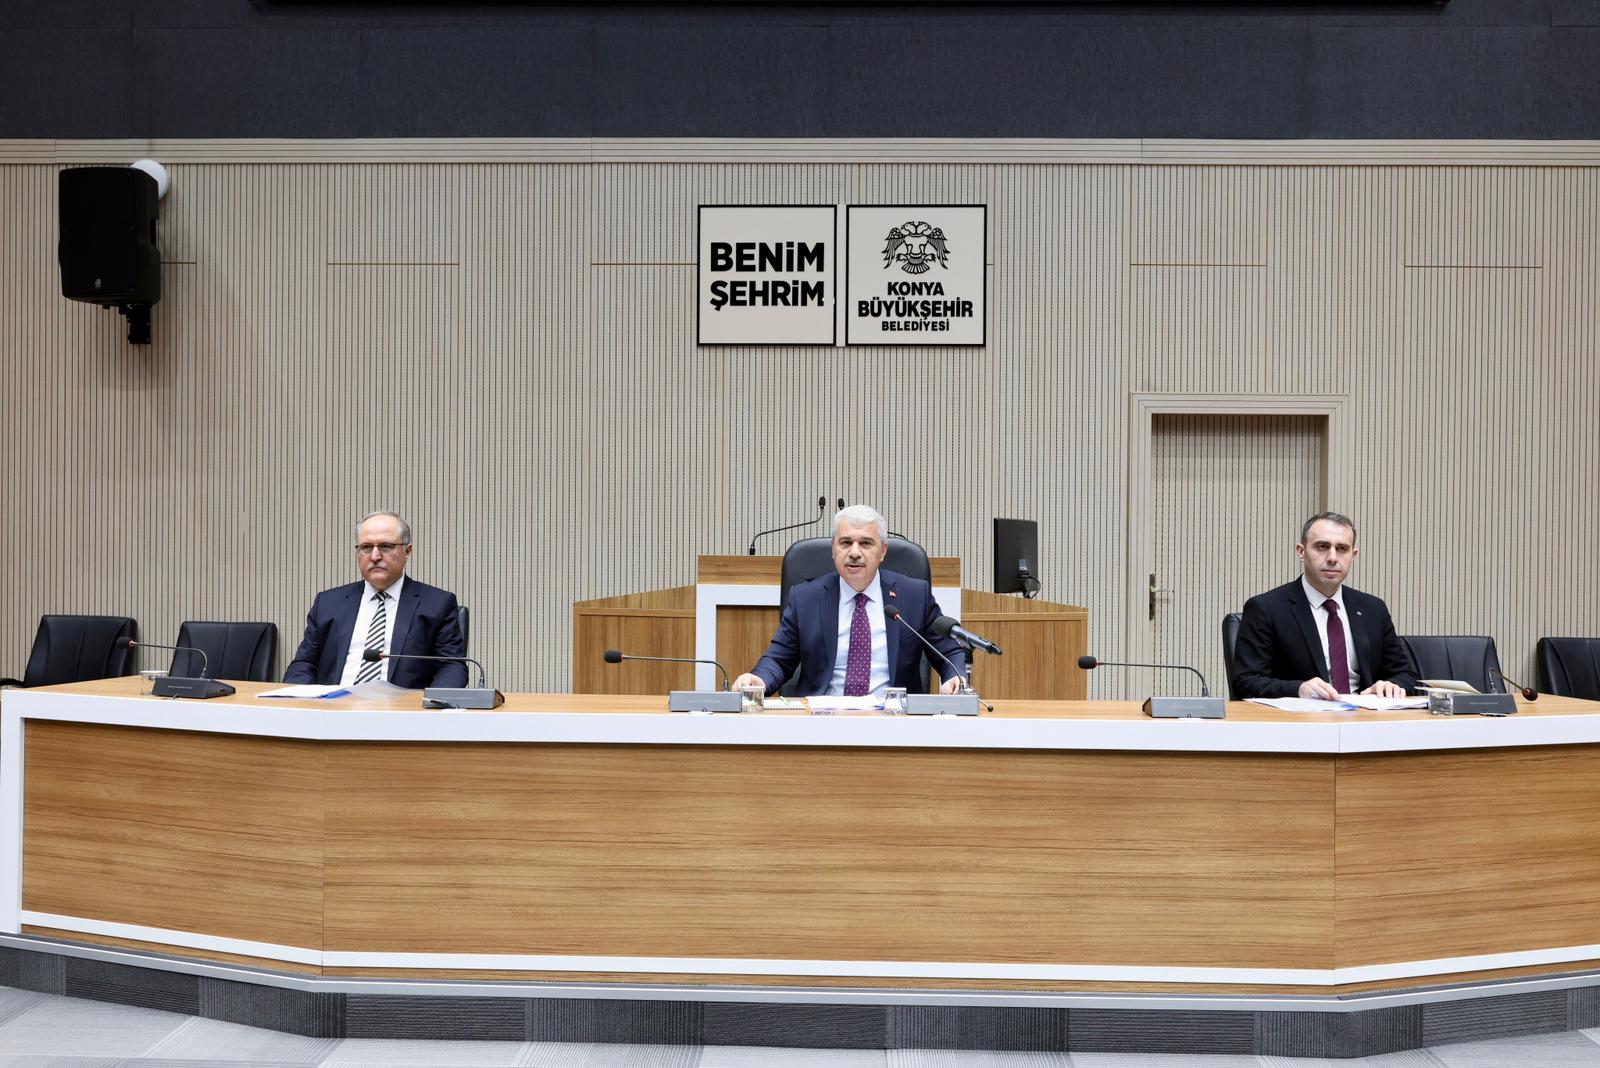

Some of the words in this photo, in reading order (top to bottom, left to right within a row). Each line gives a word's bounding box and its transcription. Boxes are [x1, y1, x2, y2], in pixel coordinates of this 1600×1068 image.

[887, 281, 945, 296] KONYA
[858, 297, 974, 320] BÜYÜKŞEHİR
[881, 319, 950, 332] BELEDİYESİ
